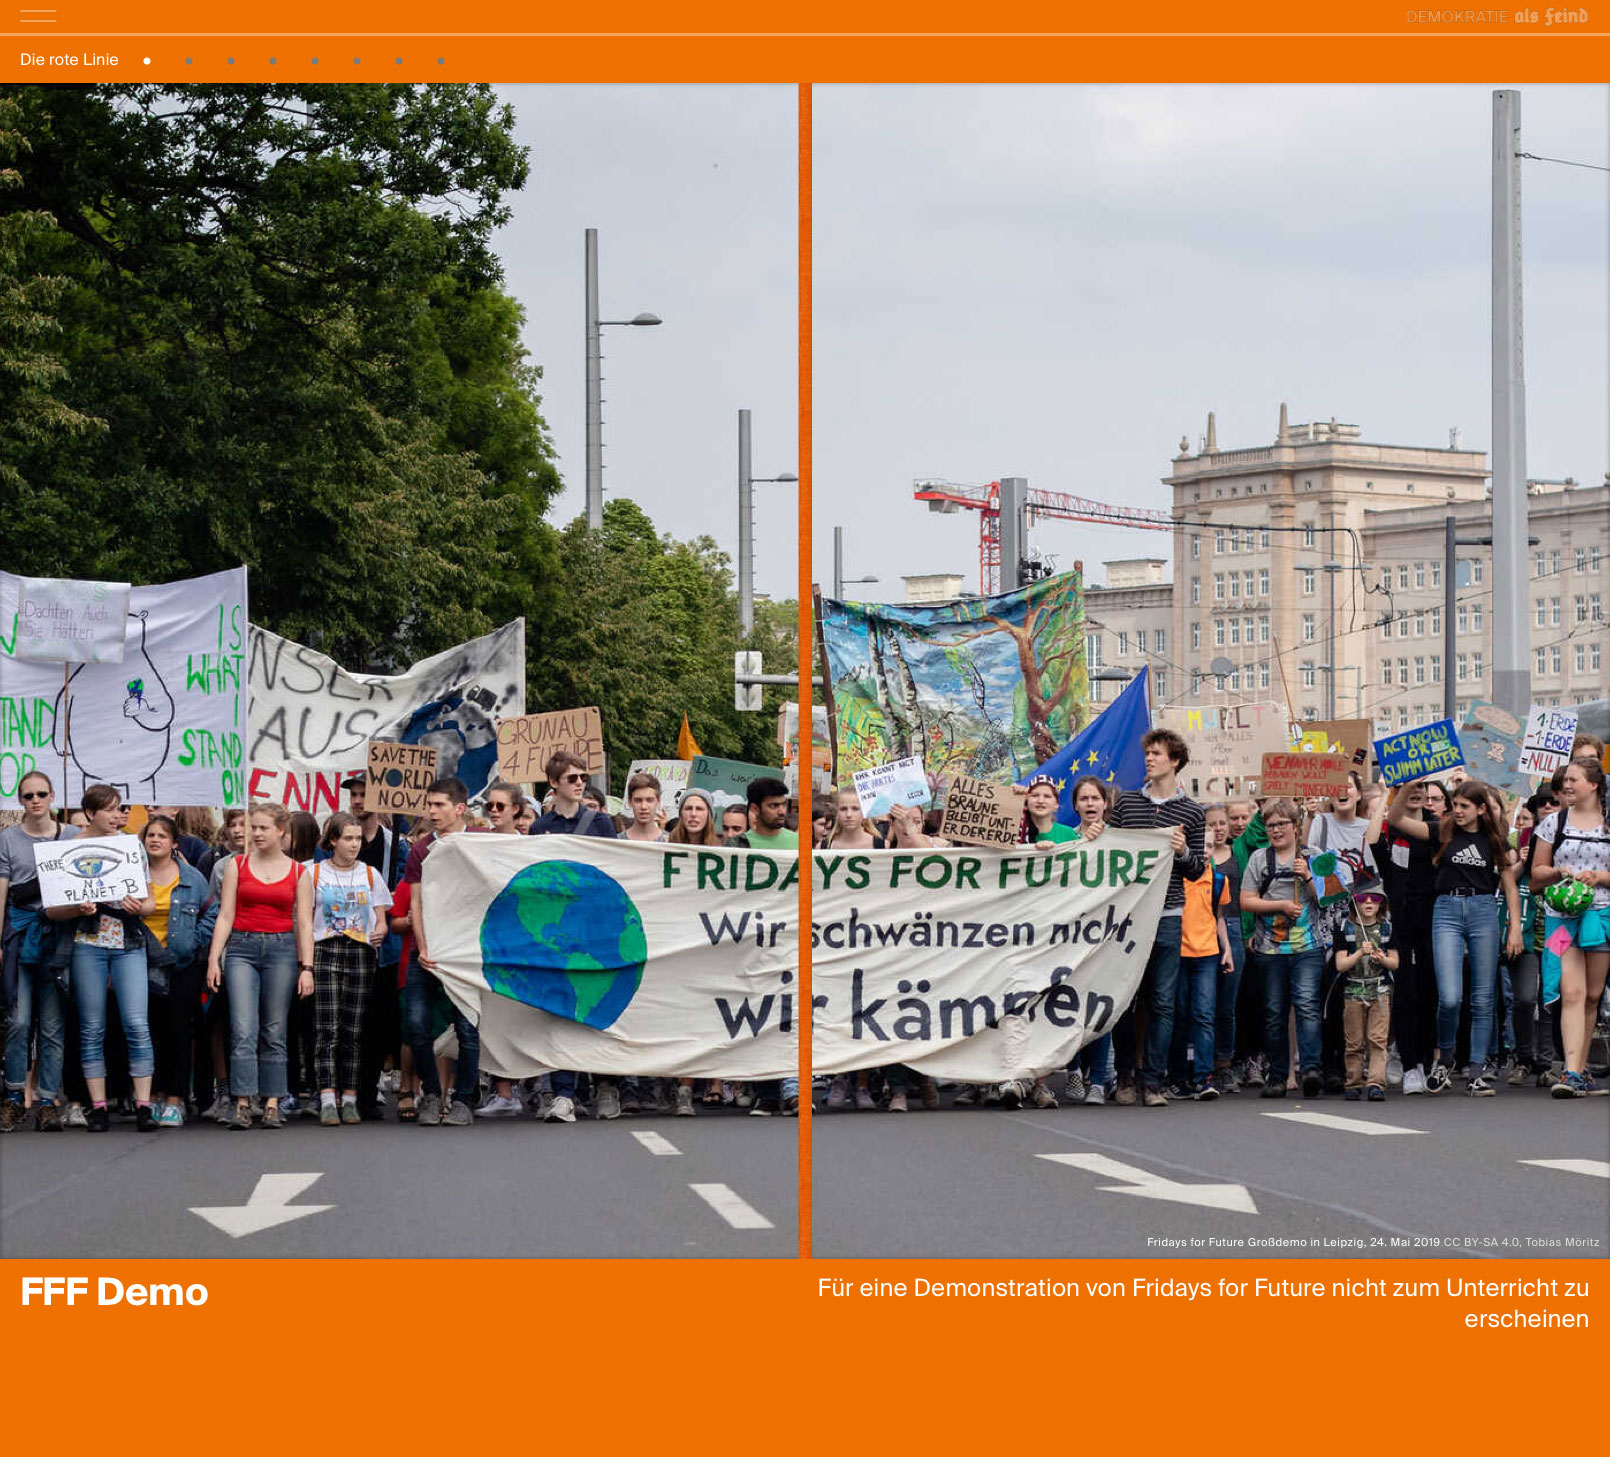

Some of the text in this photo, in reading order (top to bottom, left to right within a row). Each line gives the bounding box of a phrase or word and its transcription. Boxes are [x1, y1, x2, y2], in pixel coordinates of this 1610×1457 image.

[217, 603, 243, 651] IS
[187, 654, 245, 695] WHAT
[0, 697, 55, 748] TAND
[234, 693, 240, 728] I
[249, 704, 379, 762] AUS
[498, 712, 588, 745] GRÜNAU
[1383, 735, 1408, 758] ACT
[1409, 724, 1448, 748] NOW
[1544, 731, 1574, 752] ERDE
[178, 728, 242, 769] STAND
[371, 746, 436, 767] SAVE THE
[1408, 744, 1430, 760] OR
[1424, 746, 1462, 774] LATER
[502, 750, 520, 776] 4
[222, 774, 244, 806] ON
[378, 790, 427, 811] NOW!
[951, 776, 995, 799] ALLES
[945, 809, 989, 825] BLEIBT
[948, 794, 1000, 815] BRAUNE
[38, 851, 140, 874] THERE IS
[889, 855, 981, 889] FOR
[999, 849, 1159, 889] FUTURE
[1451, 855, 1487, 867] adidas
[64, 878, 140, 902] PLANET B
[698, 911, 787, 949] Wir
